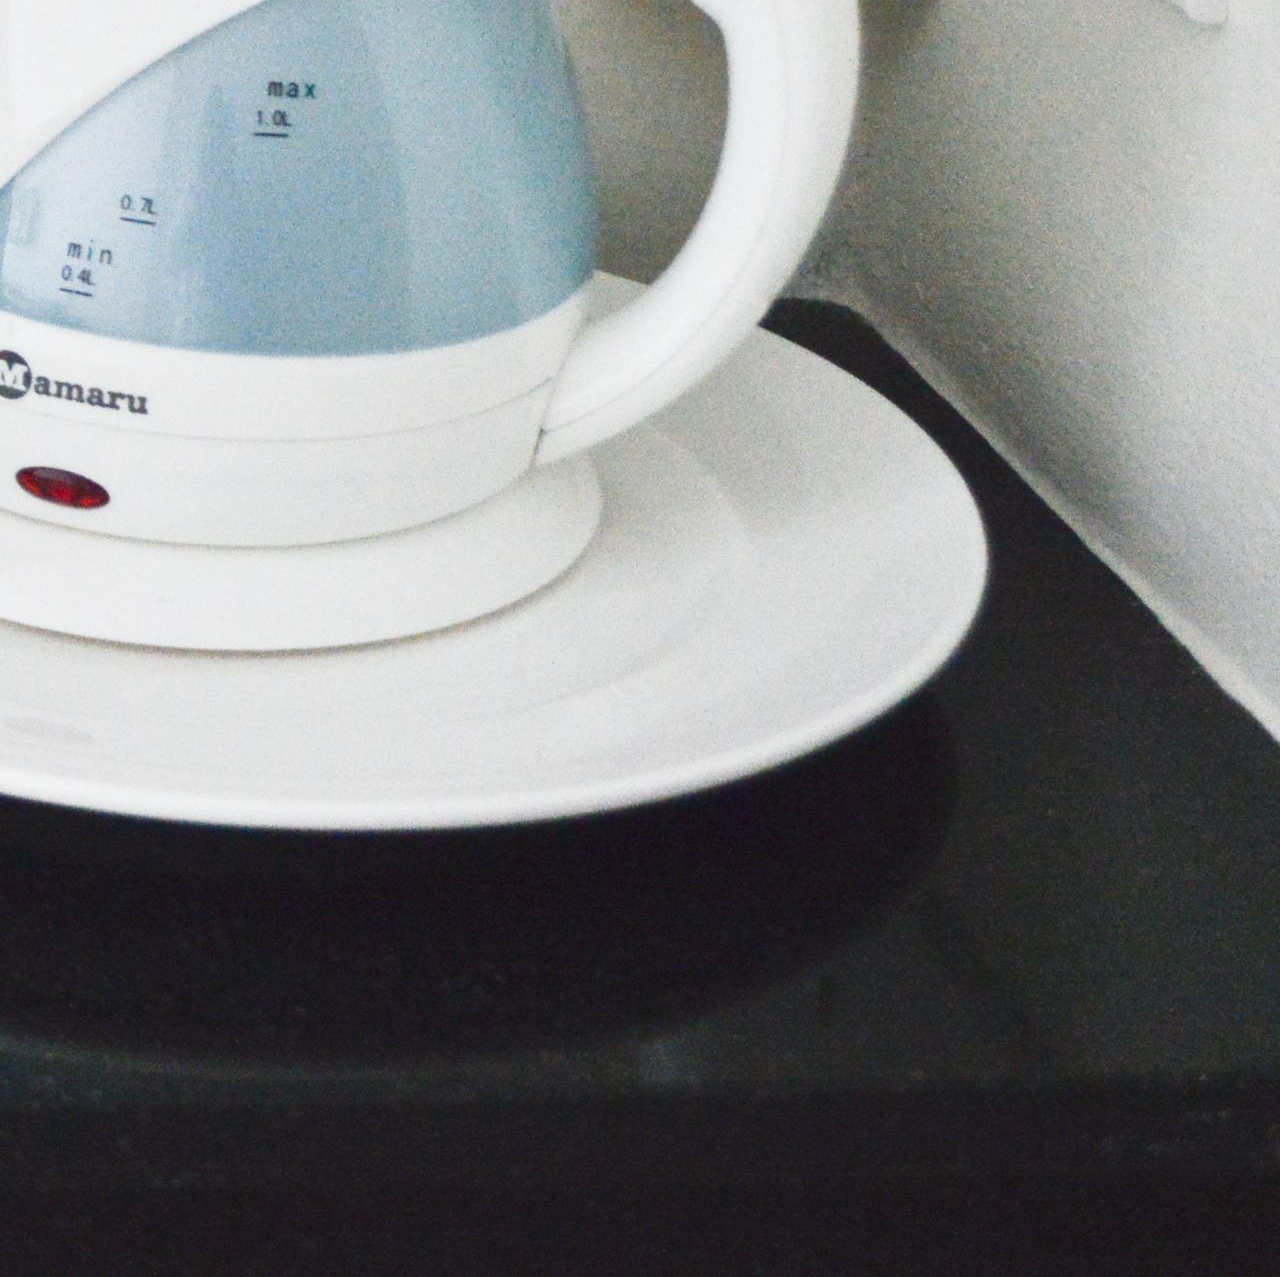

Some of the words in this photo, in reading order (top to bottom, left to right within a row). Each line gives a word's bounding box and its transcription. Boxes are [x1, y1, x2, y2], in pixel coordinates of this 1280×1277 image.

[266, 79, 317, 99] max
[120, 194, 159, 215] 0.7L
[67, 239, 114, 265] min
